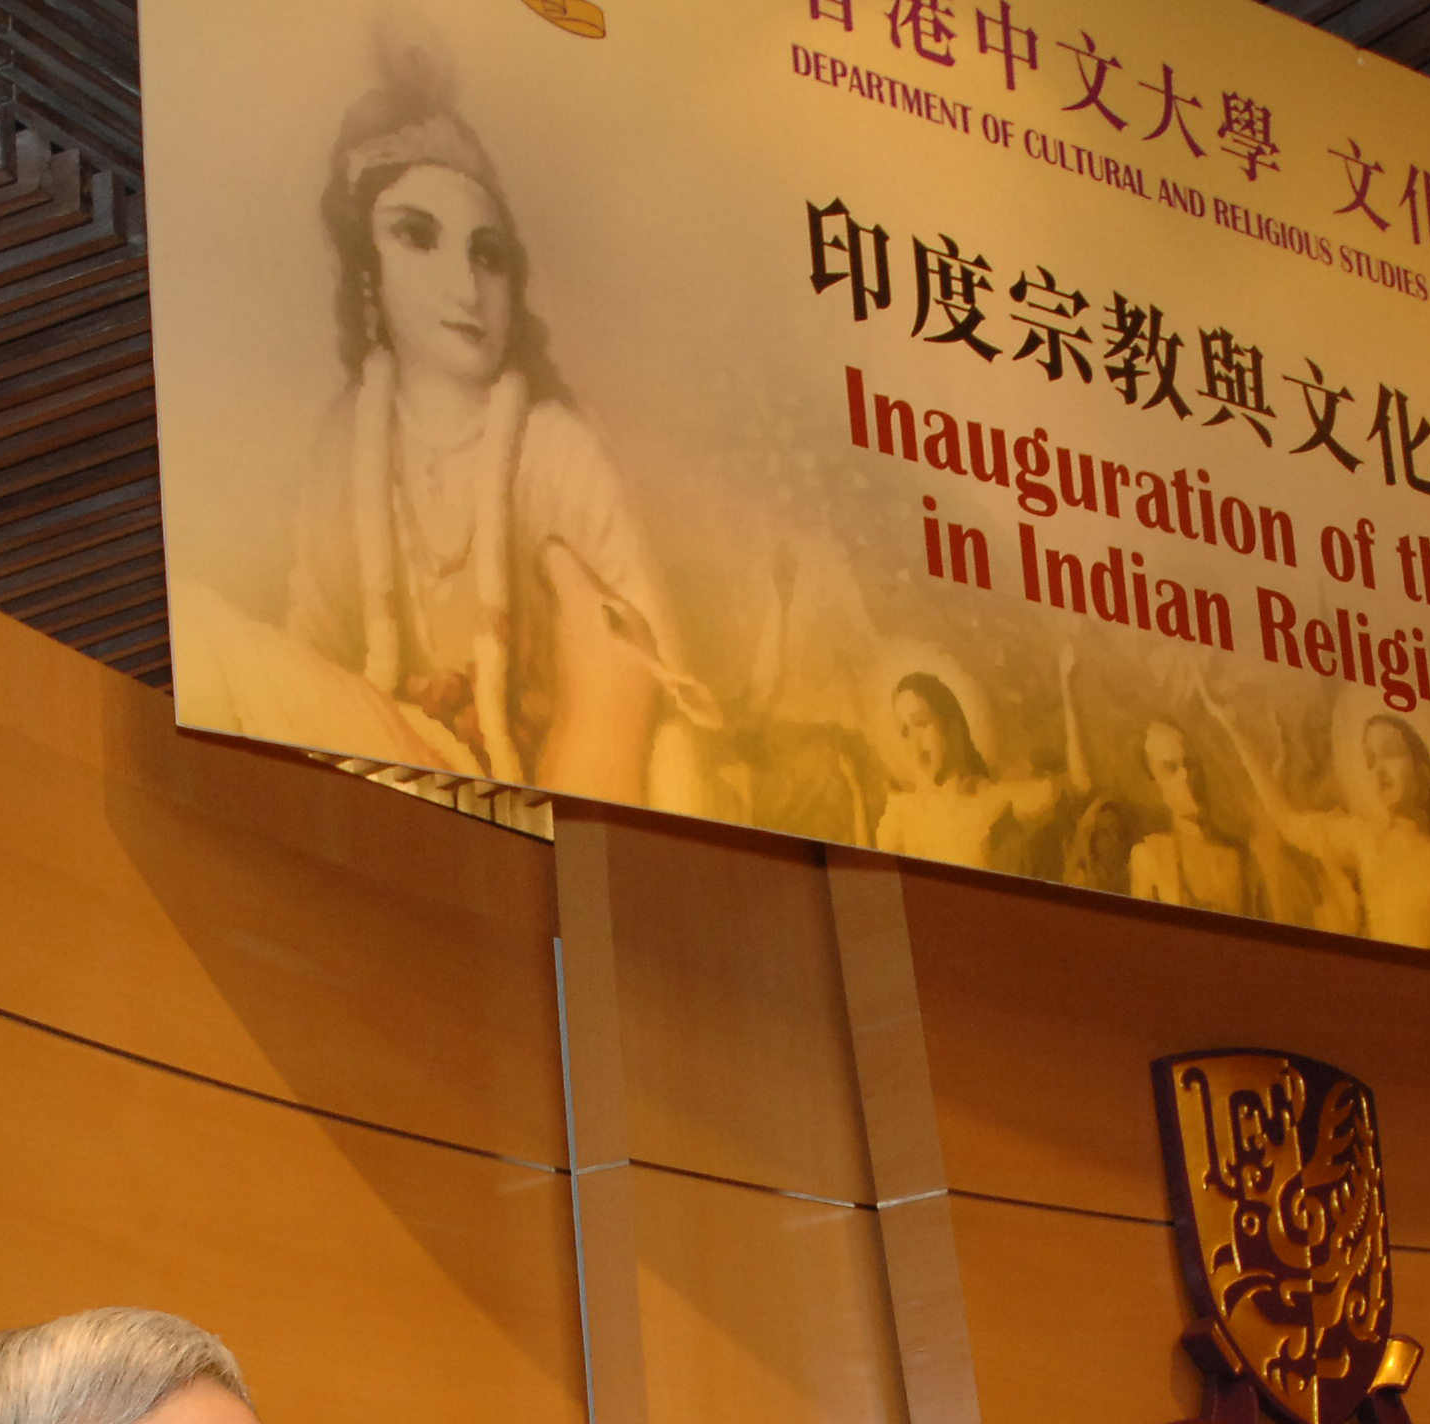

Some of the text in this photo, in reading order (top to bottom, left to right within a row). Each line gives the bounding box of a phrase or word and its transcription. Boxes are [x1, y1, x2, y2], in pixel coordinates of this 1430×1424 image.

[791, 44, 971, 134] DEPARTMENT
[981, 113, 1015, 148] OF
[1023, 129, 1152, 200] CULTURAL
[1158, 179, 1206, 218] AND
[1213, 198, 1333, 267] RELIGIOUS
[1339, 244, 1429, 301] STUDIES
[845, 365, 1297, 568] Inauguration
[1320, 517, 1376, 590] of
[922, 495, 992, 590] in
[1018, 522, 1234, 651] Indian
